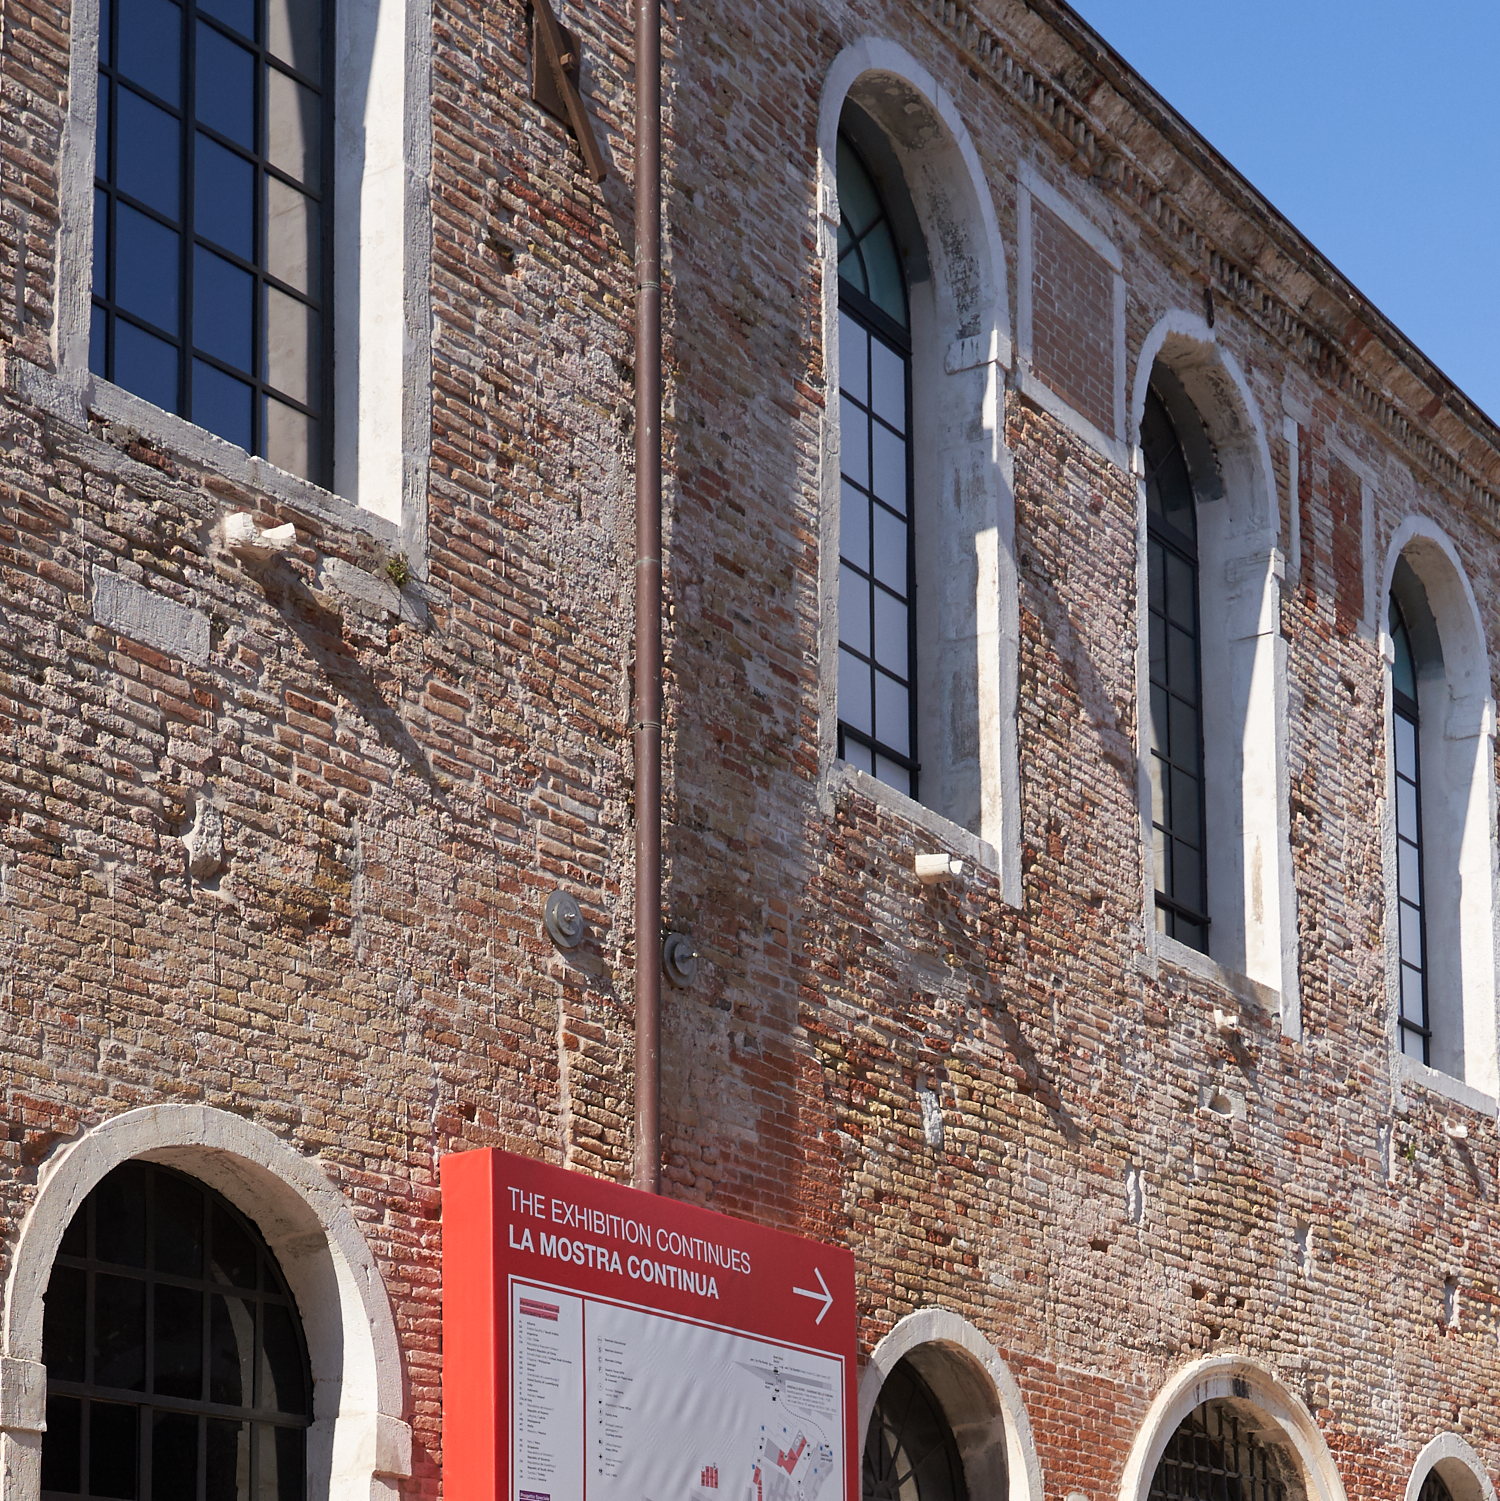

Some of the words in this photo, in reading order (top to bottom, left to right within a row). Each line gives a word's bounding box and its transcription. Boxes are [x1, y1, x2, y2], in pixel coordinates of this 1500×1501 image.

[508, 1186, 545, 1219] THE
[551, 1198, 651, 1247] EXHIBITION
[656, 1228, 751, 1274] CONTINUES
[509, 1224, 534, 1253] LA
[540, 1232, 623, 1275] MOSTRA
[627, 1255, 719, 1299] CONTINUA
